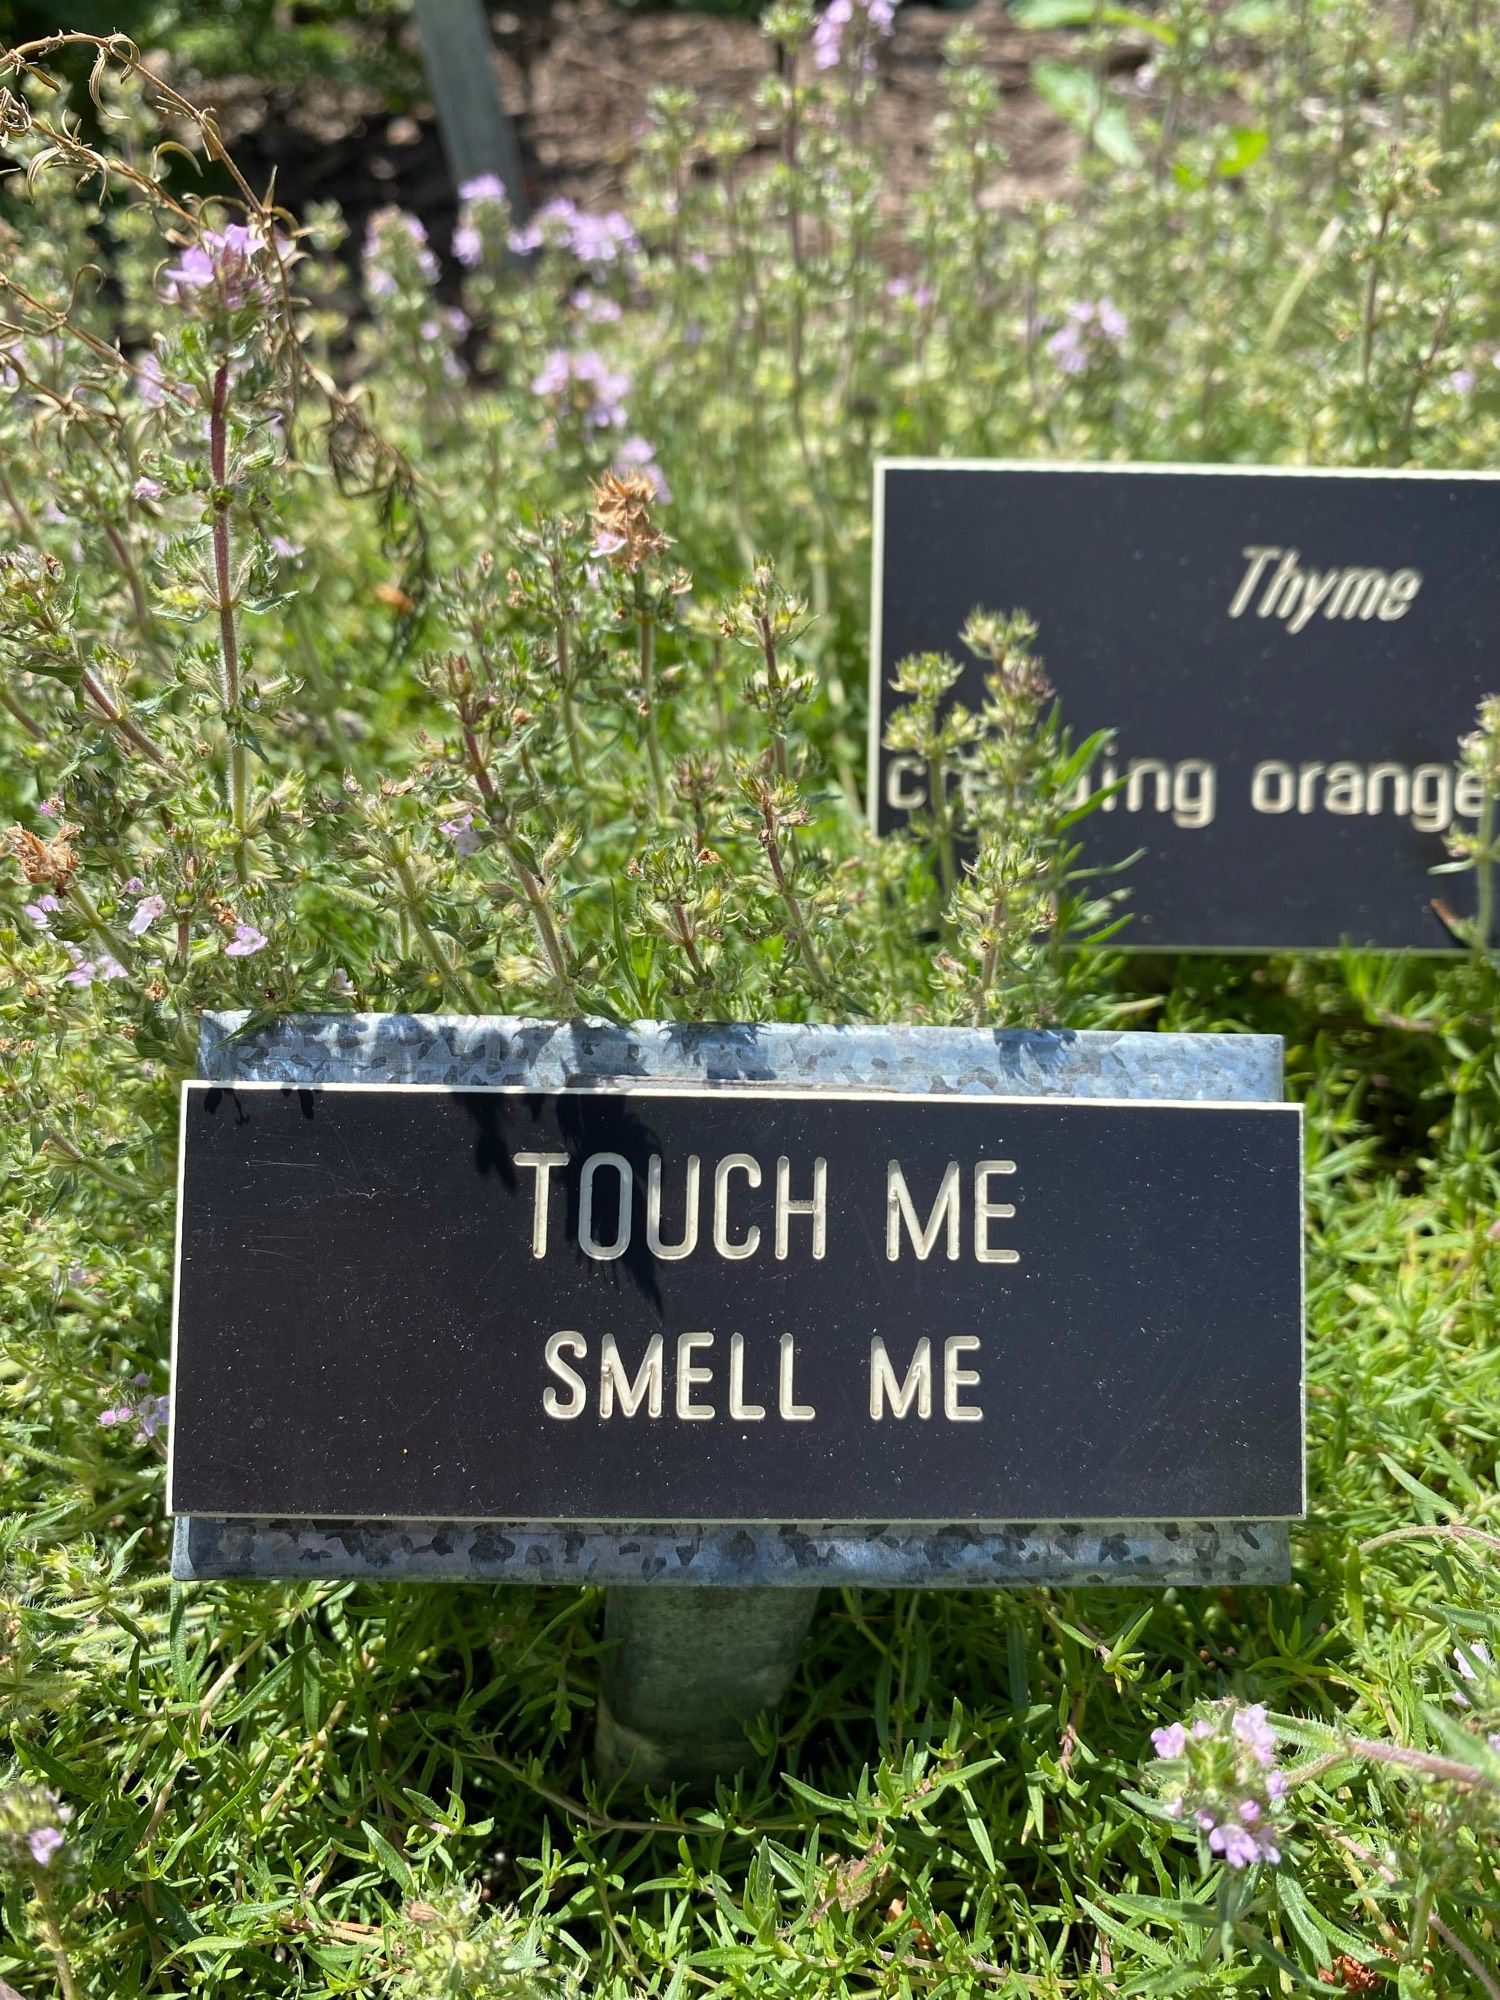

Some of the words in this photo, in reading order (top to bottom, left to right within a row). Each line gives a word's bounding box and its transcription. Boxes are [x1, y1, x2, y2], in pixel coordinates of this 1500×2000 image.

[1228, 546, 1423, 635] Thyme
[1252, 759, 1486, 833] orange
[513, 1152, 828, 1261] TOUCH
[886, 1159, 1021, 1263] ME
[543, 1330, 816, 1421] SMELL
[869, 1335, 984, 1422] ME
